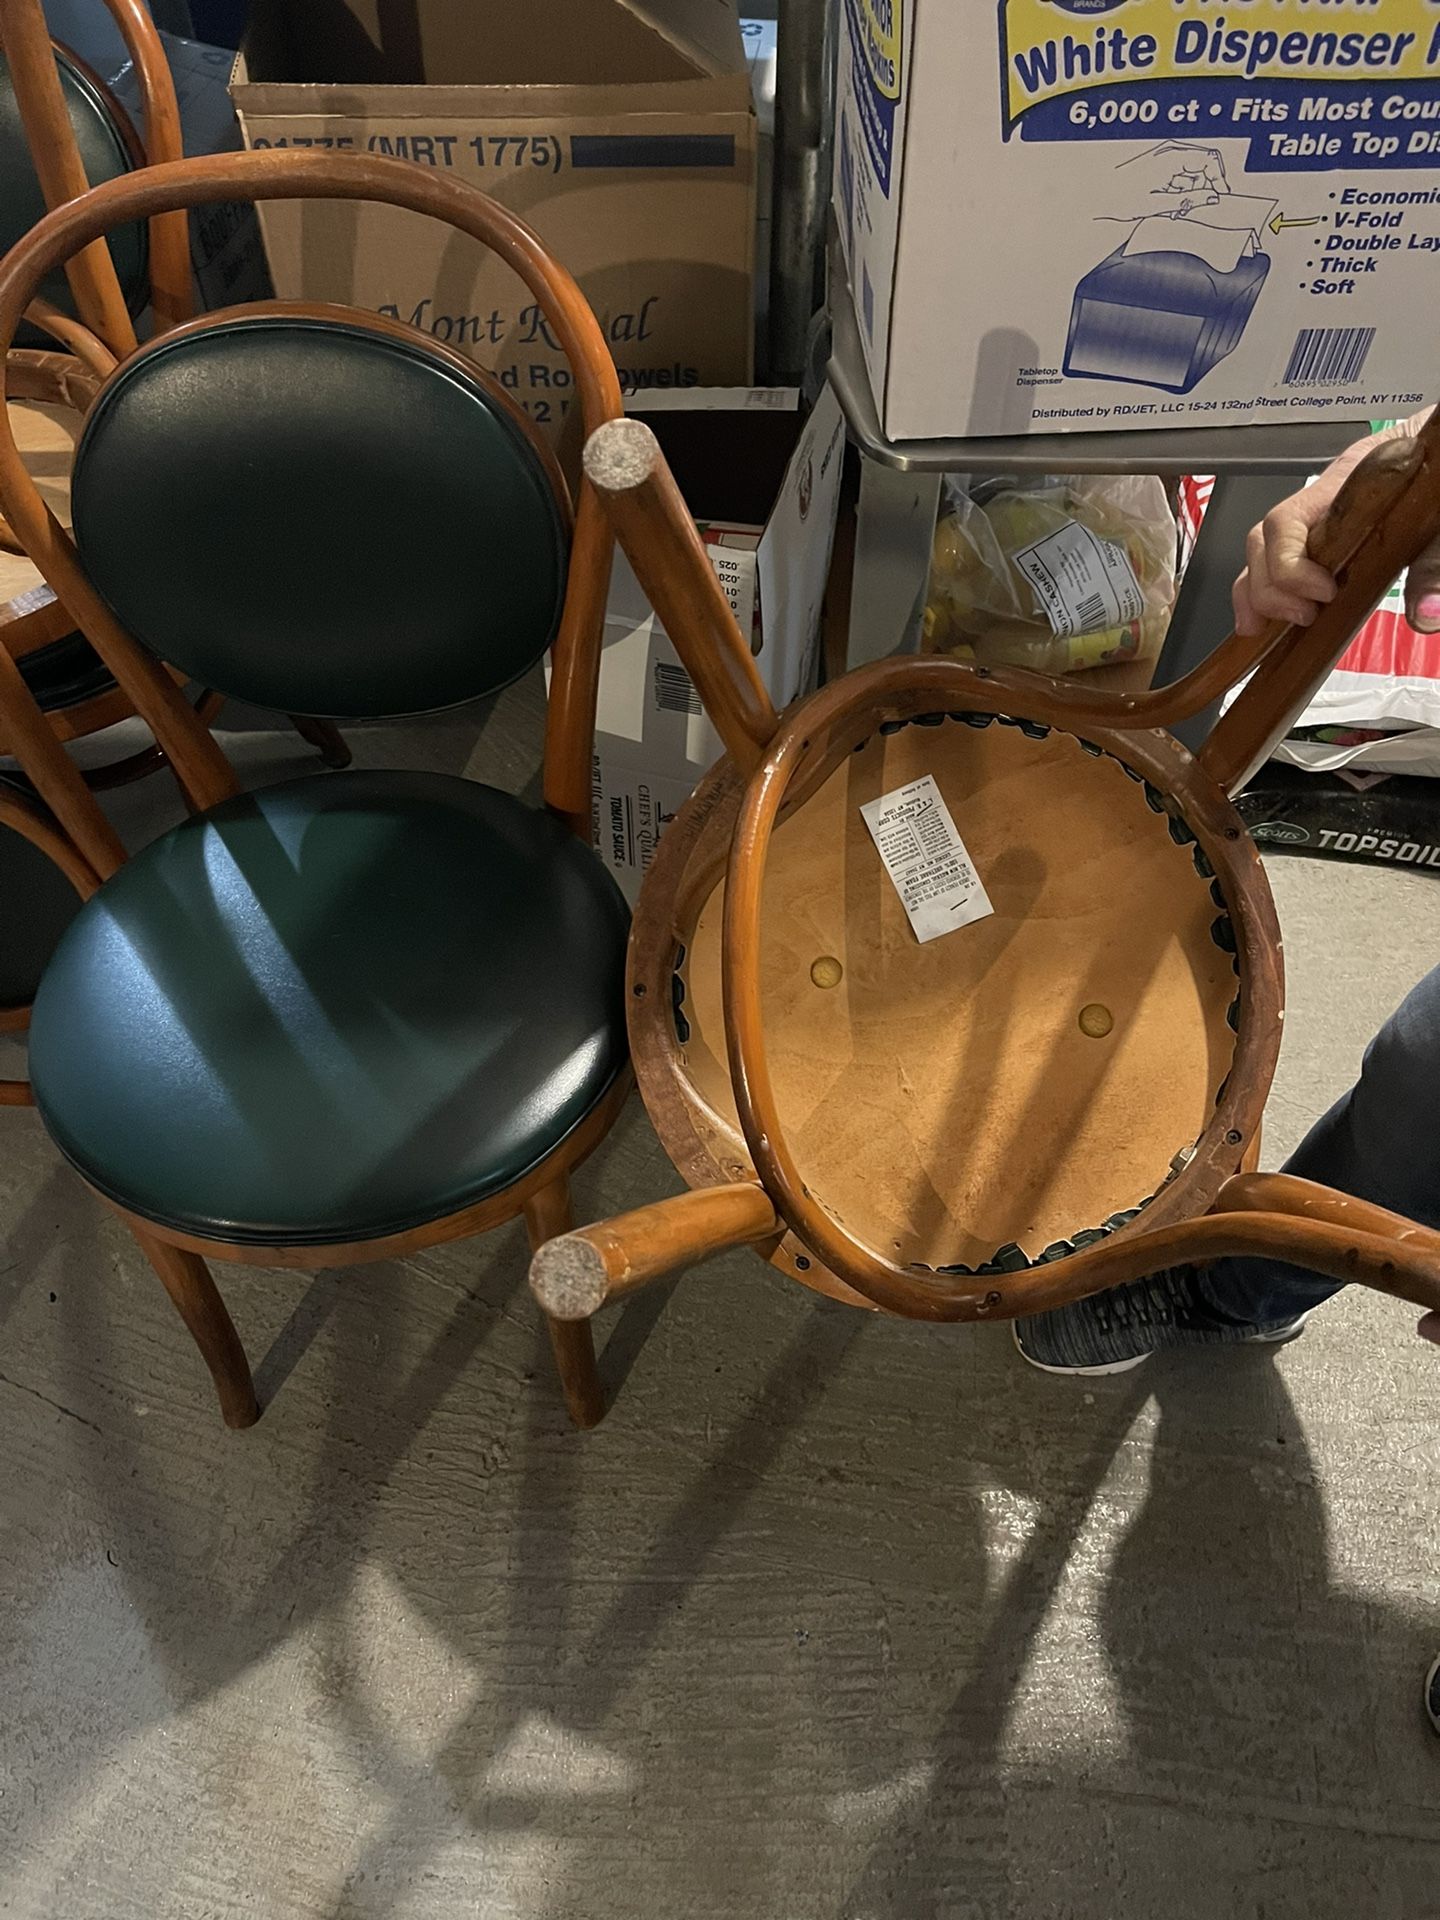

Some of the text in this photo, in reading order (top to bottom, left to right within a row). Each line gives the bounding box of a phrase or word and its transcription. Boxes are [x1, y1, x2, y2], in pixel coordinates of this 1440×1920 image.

[1015, 28, 1157, 93] White
[1174, 17, 1416, 75] Dispenser
[1069, 101, 1158, 129] 6,000
[1167, 101, 1200, 123] ct
[1231, 98, 1288, 122] Fits
[1298, 97, 1374, 121] Most
[469, 135, 562, 174] 1775)
[1269, 134, 1342, 156] Table
[1352, 132, 1400, 158] Top
[1335, 212, 1404, 228] V-Fold
[1325, 235, 1402, 251] Double
[1320, 257, 1378, 273] Thick
[1310, 279, 1356, 294] Soft
[378, 297, 658, 350] Mont Ral
[615, 363, 699, 387] owels
[1016, 378, 1064, 387] Dispenser
[1018, 368, 1059, 377] Tabletop
[1032, 393, 1424, 418] Distributed by RD/JET, LLC 15-24 132nd Street College Point, NY 11356
[1029, 562, 1059, 607] CASHEW
[609, 796, 625, 861] TOMATO SAUCE
[636, 784, 652, 878] CHEF'S QUALI
